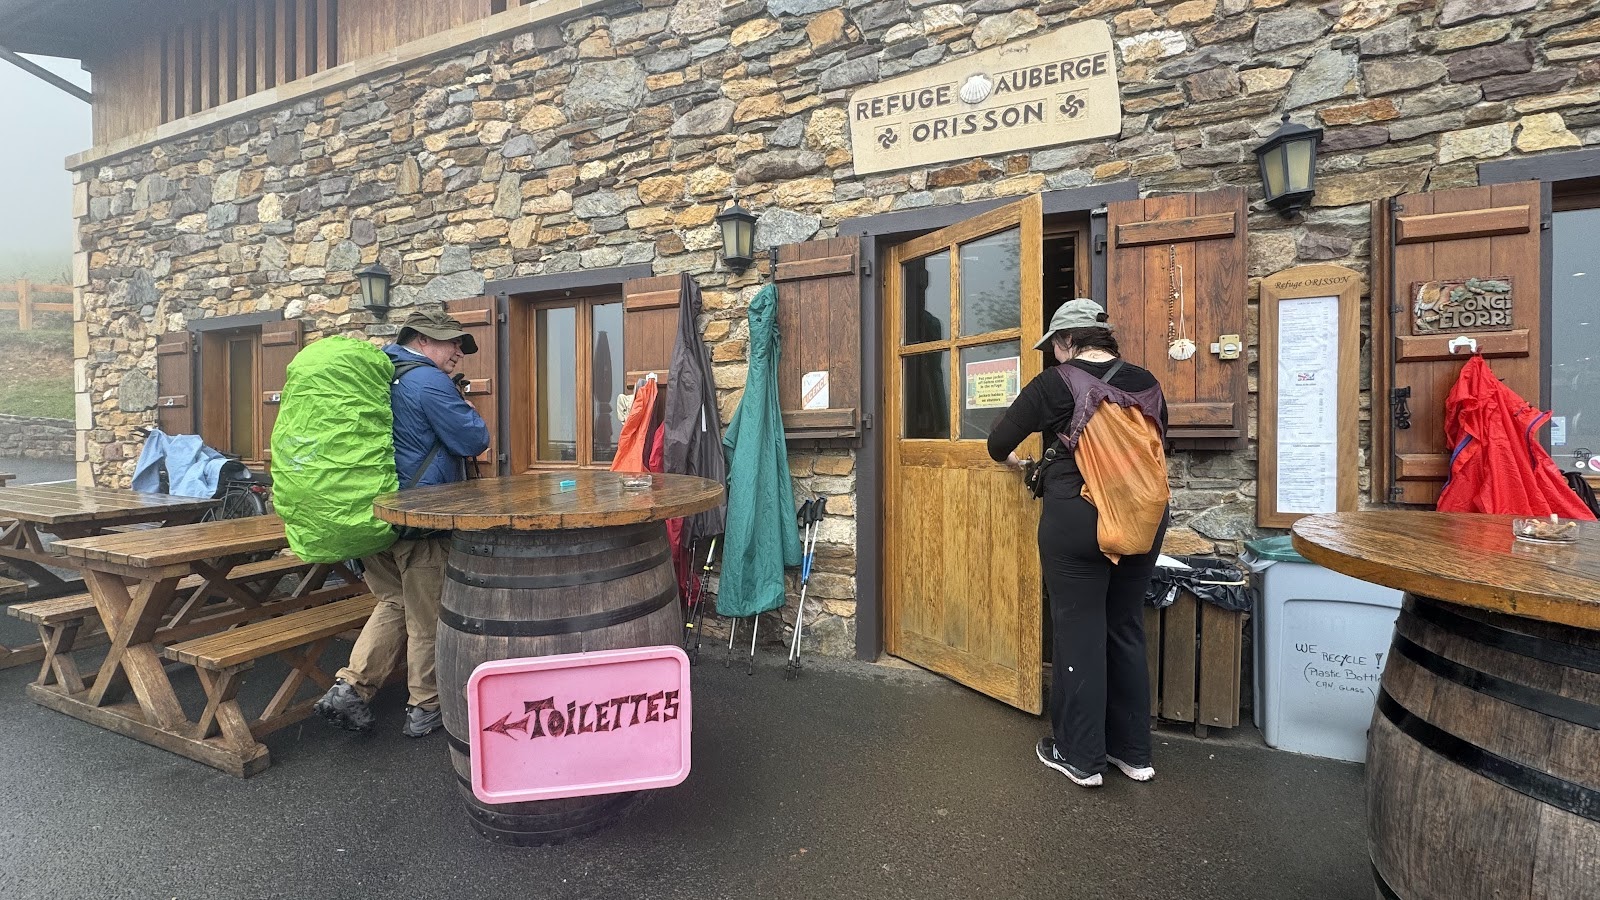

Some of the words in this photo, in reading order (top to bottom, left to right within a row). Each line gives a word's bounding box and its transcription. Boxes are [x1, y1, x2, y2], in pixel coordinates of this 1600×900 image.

[856, 85, 951, 121] REFUGE
[994, 53, 1108, 95] AUBERGE
[912, 101, 1043, 143] ORISSON
[1275, 280, 1303, 289] Refuge
[1304, 275, 1351, 287] ORISSON
[1295, 643, 1317, 653] WE
[1321, 651, 1367, 666] RECYCLE
